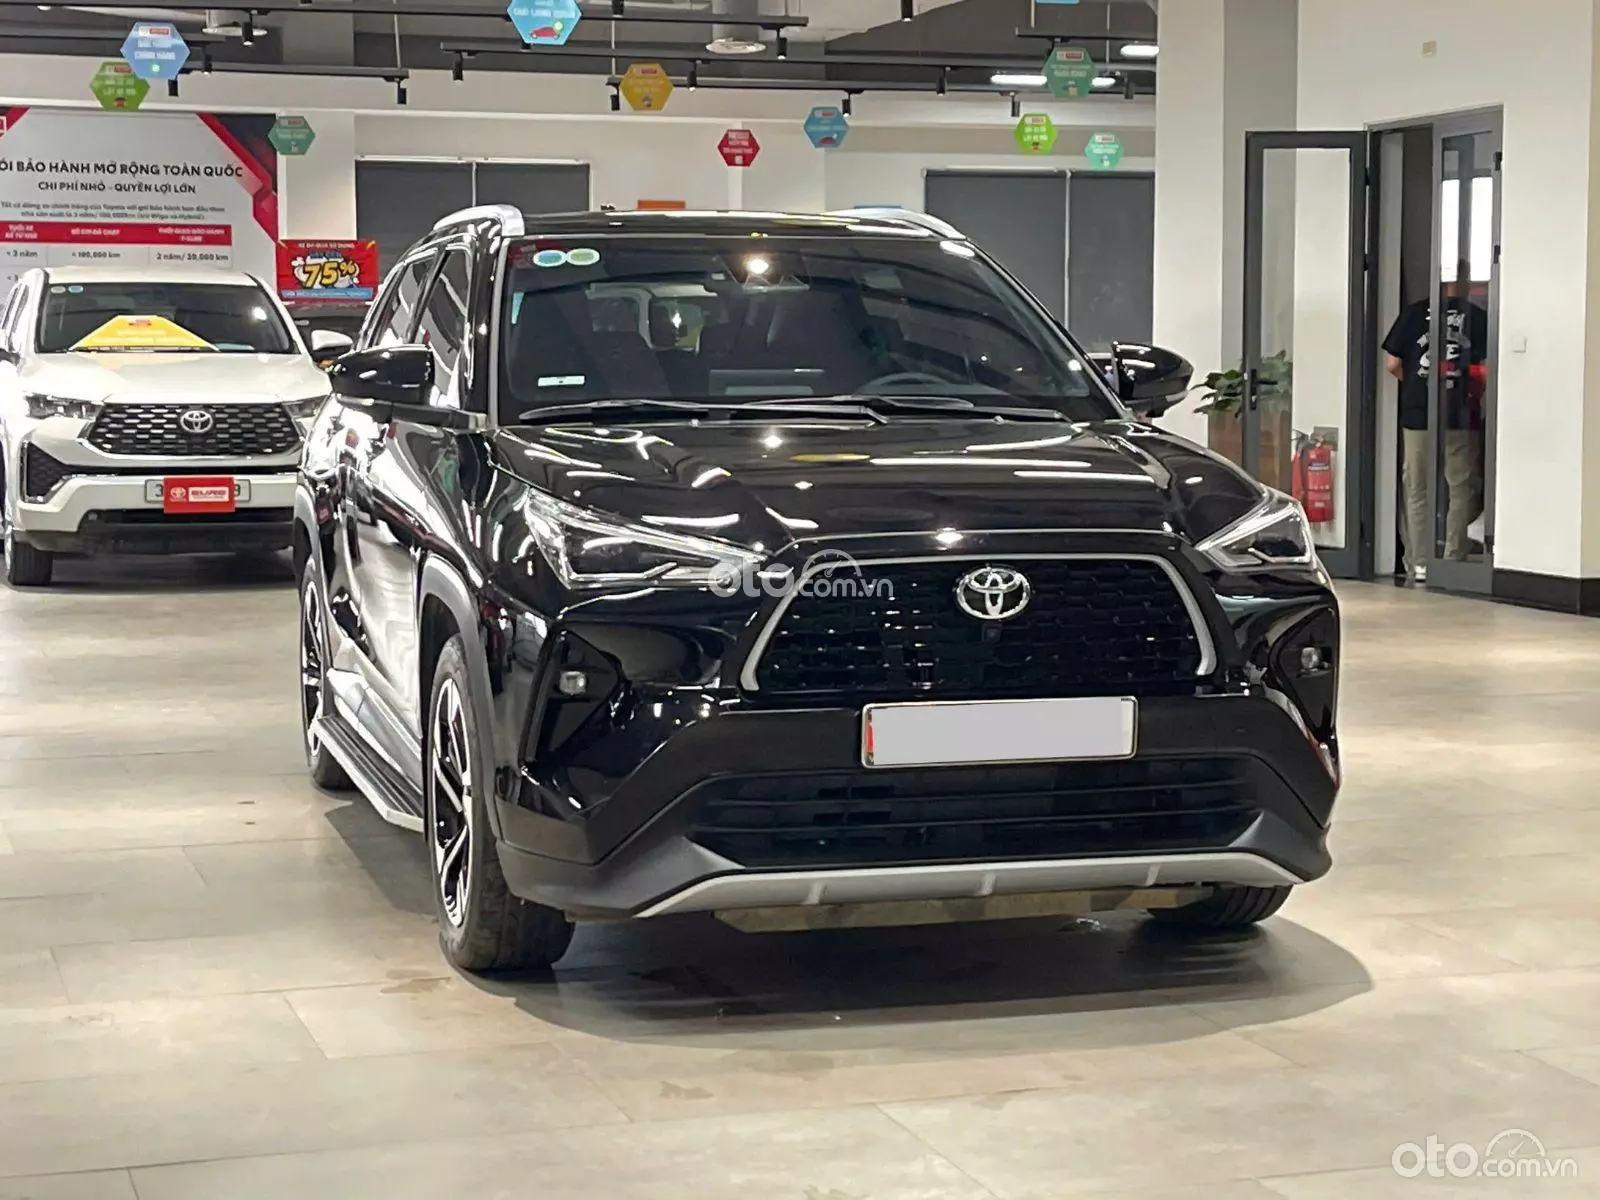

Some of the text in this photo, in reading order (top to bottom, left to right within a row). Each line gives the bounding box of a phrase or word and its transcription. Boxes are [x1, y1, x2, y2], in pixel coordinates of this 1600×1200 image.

[16, 157, 46, 172] BẢO
[49, 159, 90, 174] HÀNH
[120, 161, 160, 177] RỘNG
[163, 162, 200, 176] TOÀN
[204, 163, 244, 178] QUỐC
[38, 181, 57, 191] CHI
[59, 180, 78, 191] PHÍ
[80, 179, 106, 192] NHỎ
[114, 182, 152, 193] QUYỀN
[304, 261, 357, 288] 75%
